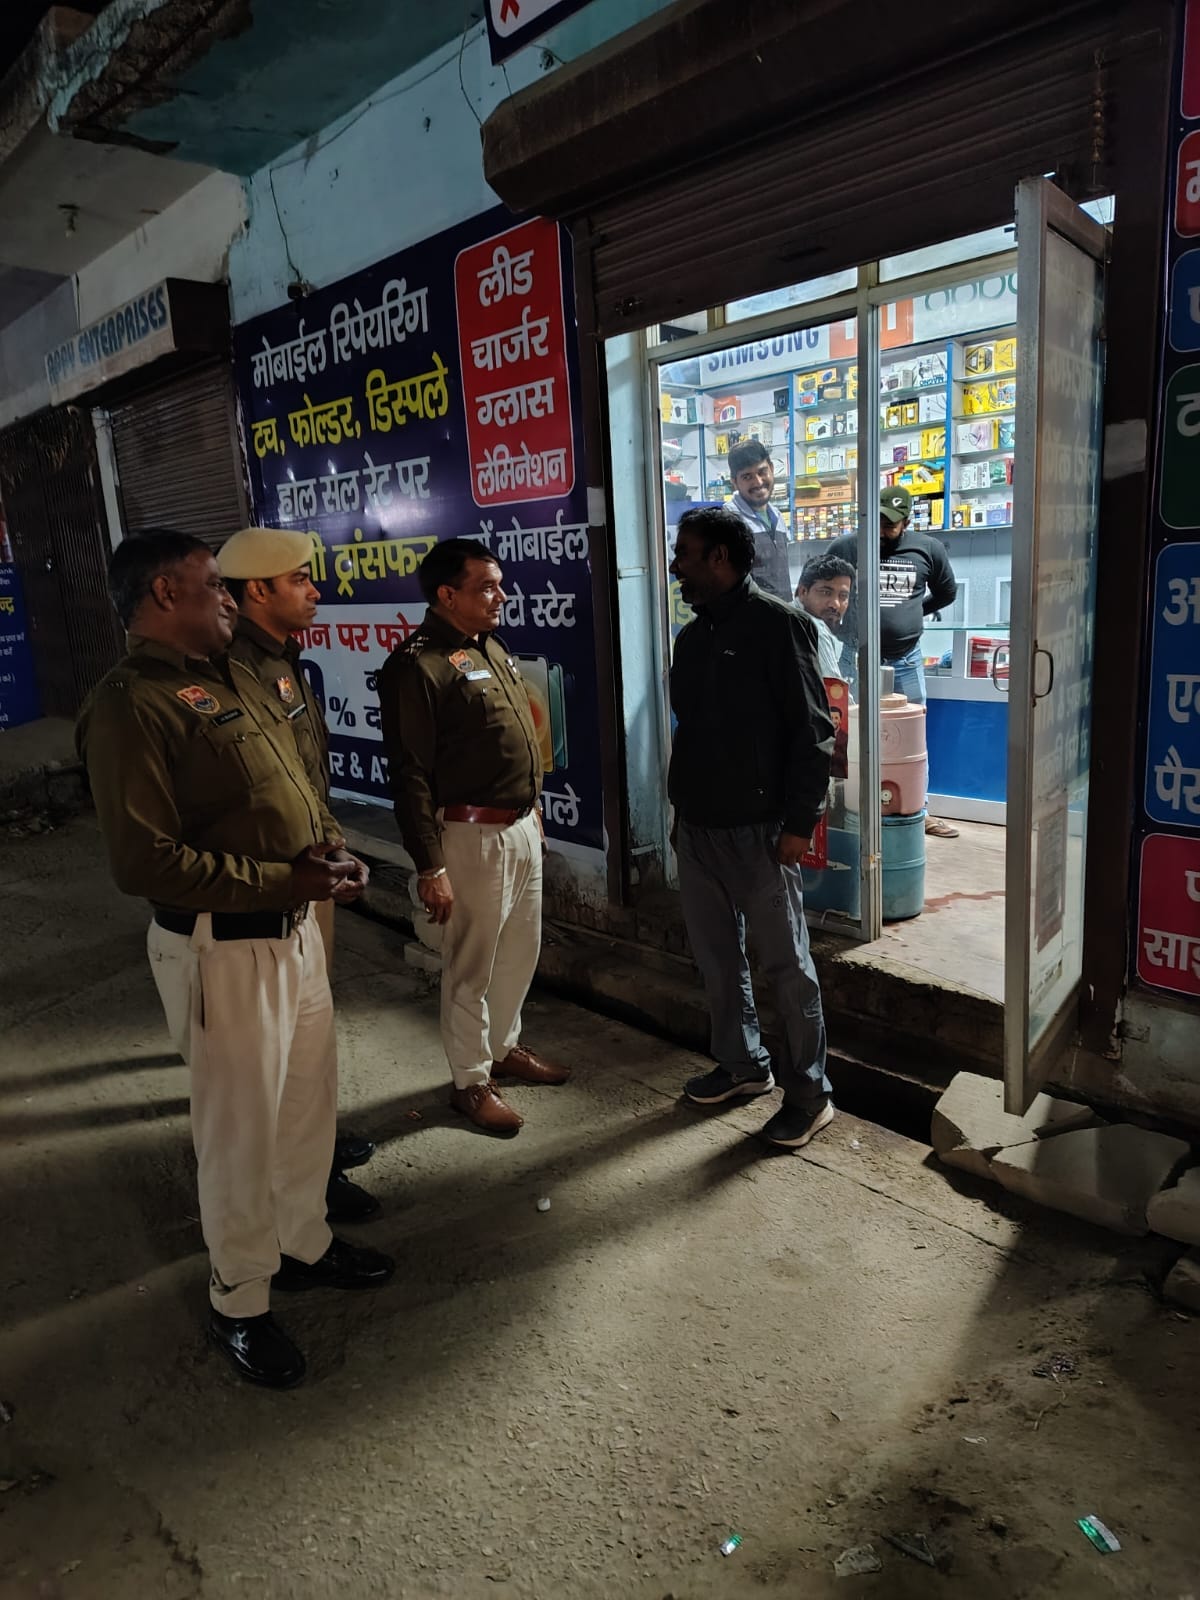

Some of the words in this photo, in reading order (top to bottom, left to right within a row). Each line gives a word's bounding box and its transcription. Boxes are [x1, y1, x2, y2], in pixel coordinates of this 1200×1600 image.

[477, 246, 535, 307] लीड
[78, 285, 166, 366] ENTERPRISES
[250, 318, 327, 389] मोबाईल
[329, 277, 429, 365] रिपेयरिंग
[471, 305, 550, 370] चार्जर
[708, 328, 820, 373] SAMSUNG
[288, 392, 361, 447] फोल्डर,
[366, 351, 449, 432] डिस्पले
[475, 377, 555, 428] ग्लास
[396, 456, 431, 501] पर
[476, 441, 567, 496] लेमिनेशन
[496, 507, 590, 565] मोबाईल
[529, 580, 576, 628] स्टेट
[336, 623, 370, 652] पर
[329, 697, 356, 728] %
[350, 751, 365, 780] &
